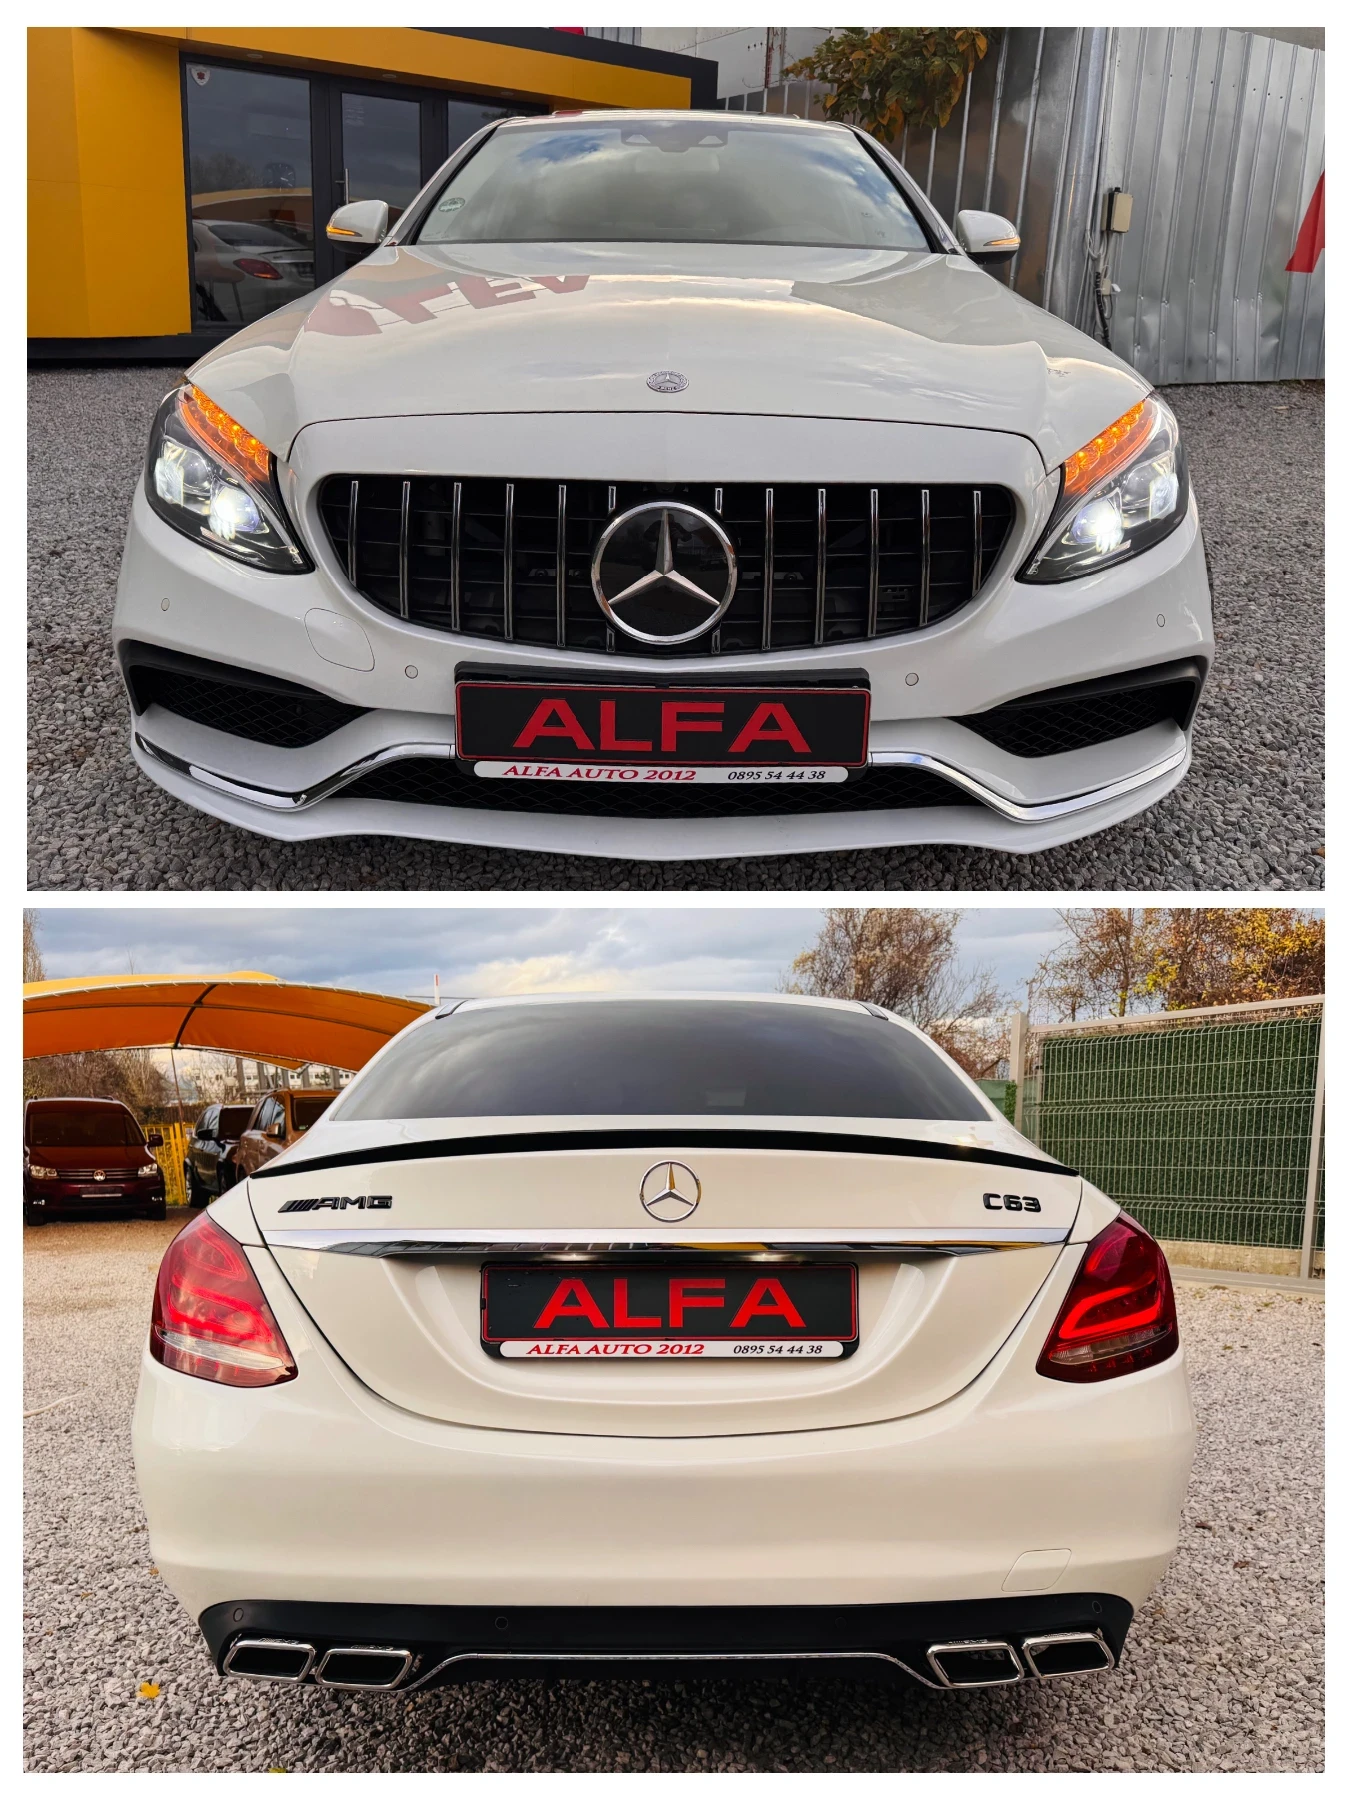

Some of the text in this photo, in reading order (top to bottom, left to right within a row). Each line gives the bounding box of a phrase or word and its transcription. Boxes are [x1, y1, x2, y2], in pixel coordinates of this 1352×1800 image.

[512, 698, 812, 753] ALFA
[503, 765, 827, 782] ALFA AUTO 2012 0895 54 44 38
[311, 1196, 393, 1210] AMG
[982, 1193, 1042, 1213] C63
[532, 1278, 807, 1329] ALFA
[526, 1343, 824, 1356] ALFA AUTO 2012 0895 54 44 38
